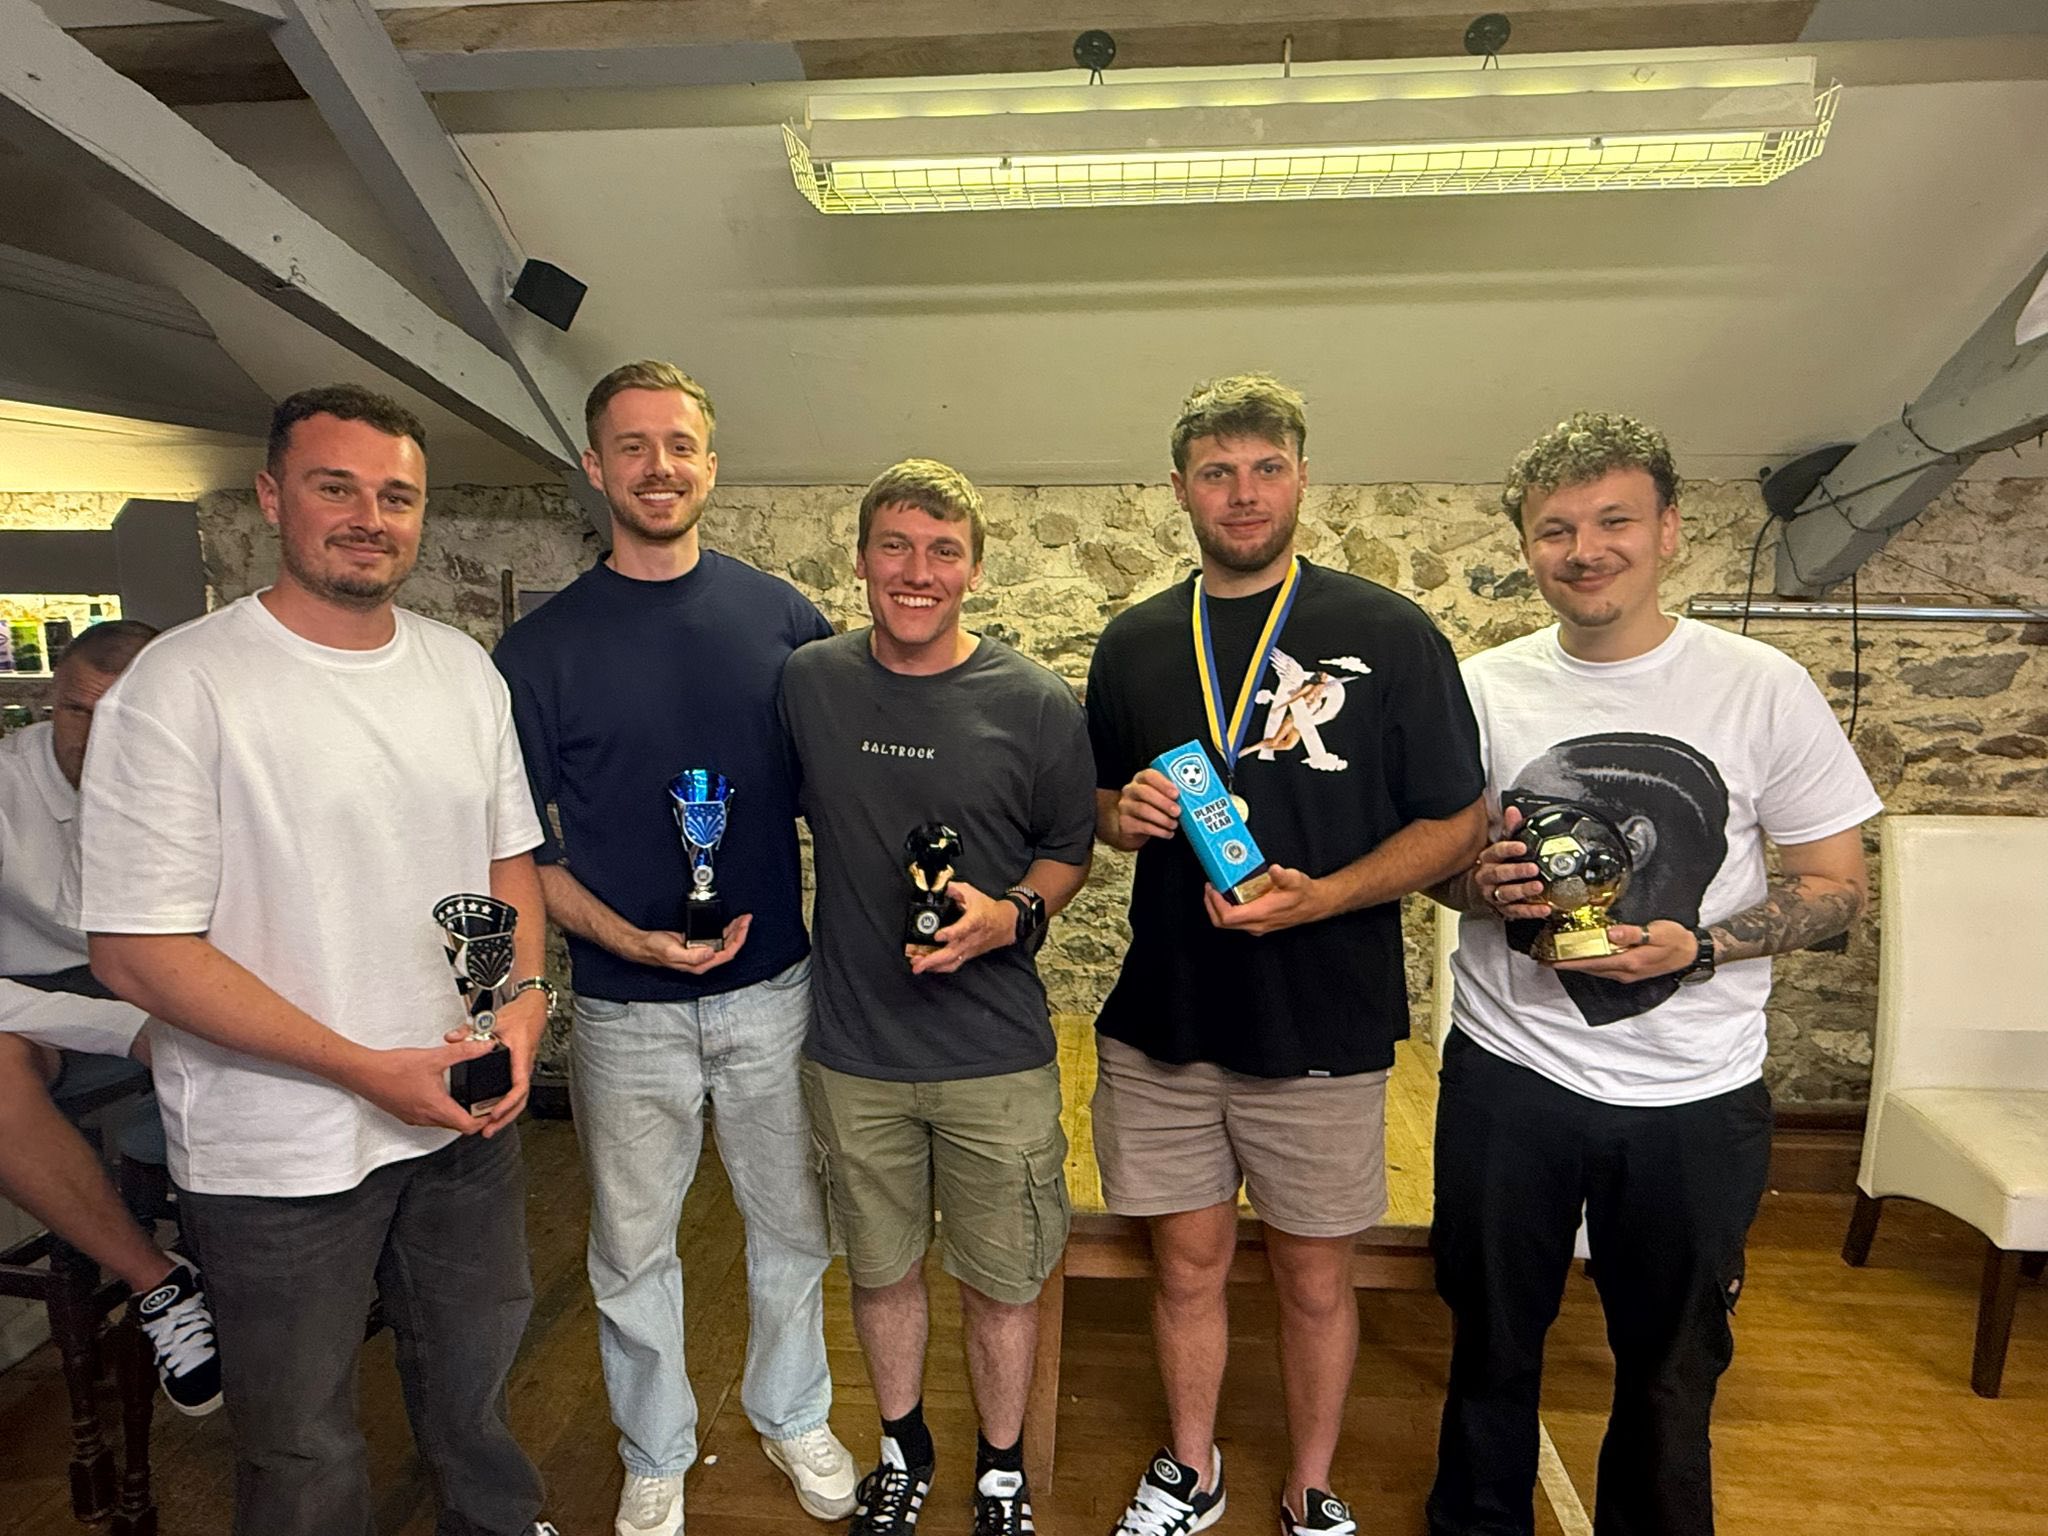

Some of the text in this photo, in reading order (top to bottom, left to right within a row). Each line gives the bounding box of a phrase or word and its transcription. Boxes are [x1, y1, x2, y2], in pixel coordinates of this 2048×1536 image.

[861, 740, 935, 760] SALTROCK
[1193, 798, 1228, 820] PLAYER
[1203, 809, 1226, 824] OF THE
[1206, 815, 1232, 832] YEAR
